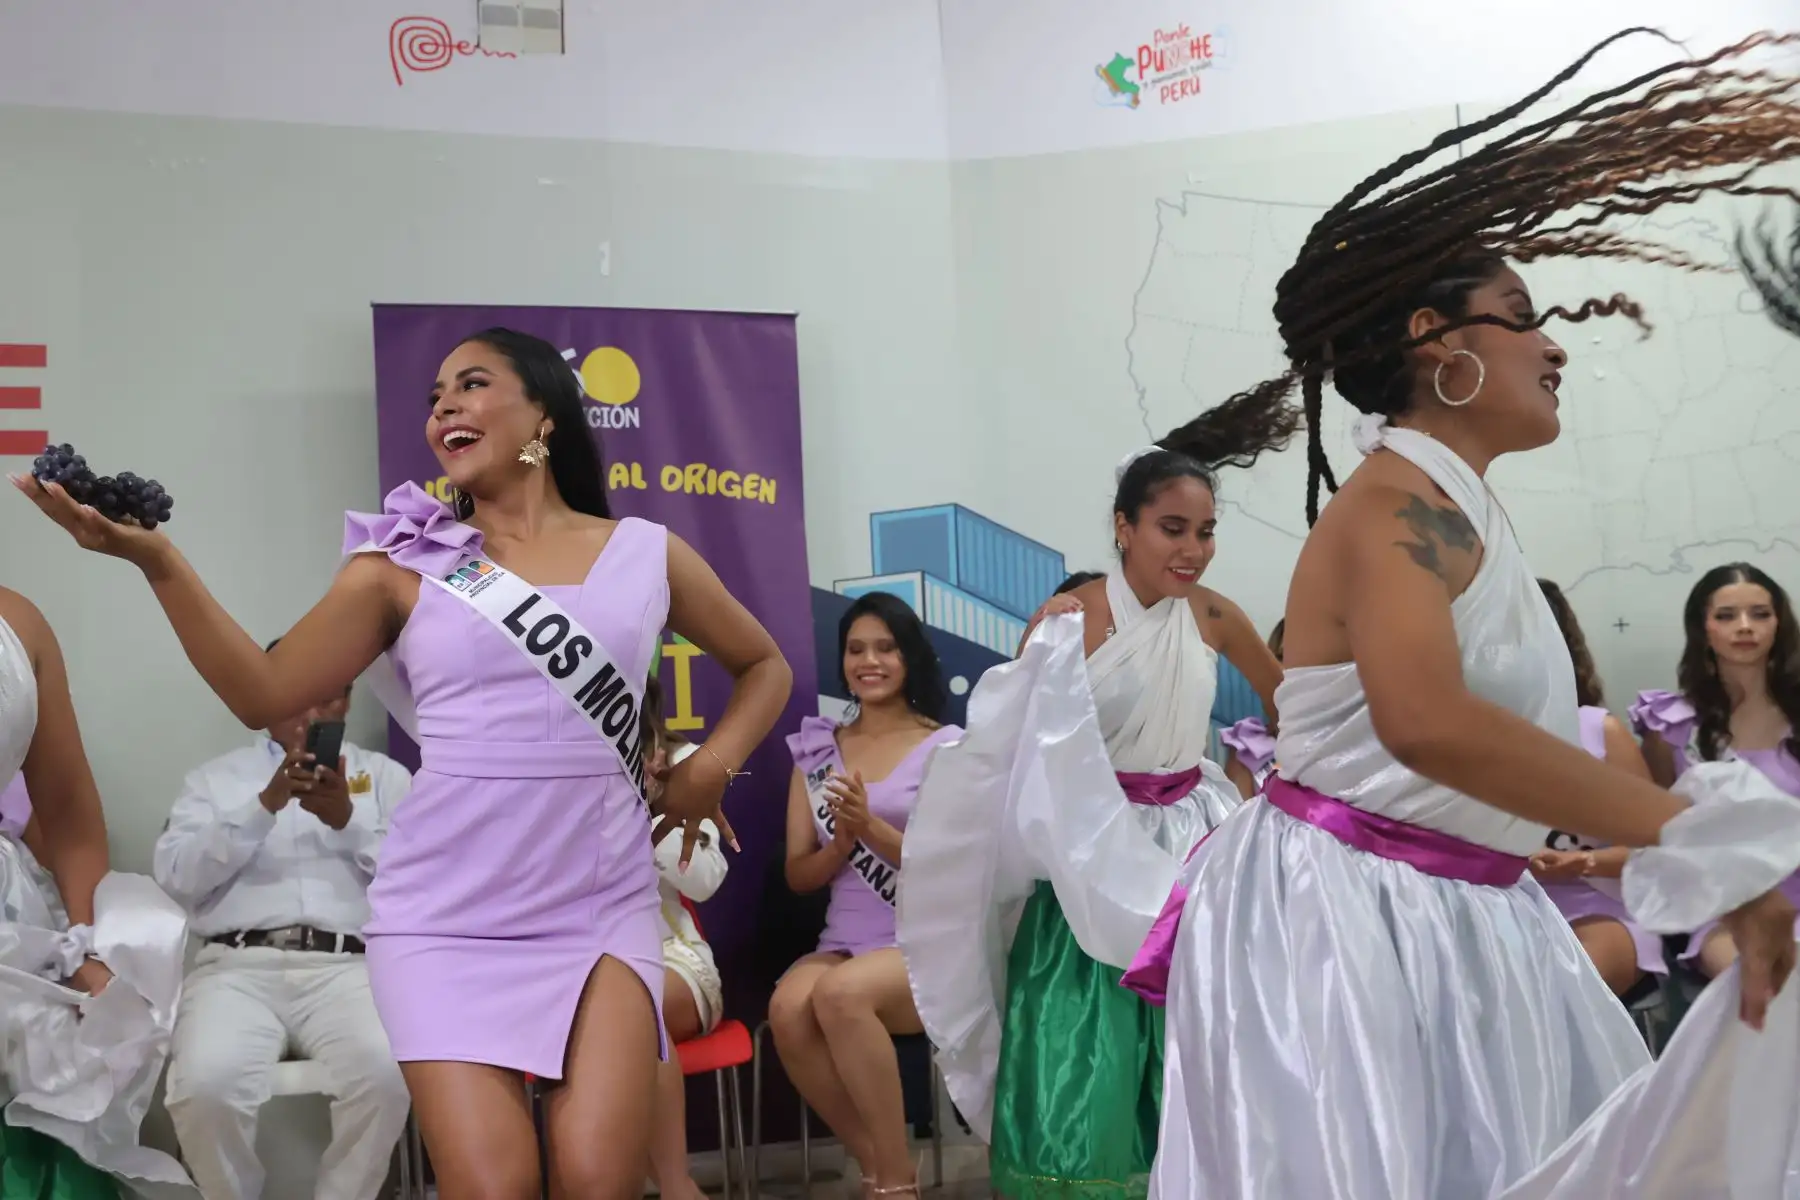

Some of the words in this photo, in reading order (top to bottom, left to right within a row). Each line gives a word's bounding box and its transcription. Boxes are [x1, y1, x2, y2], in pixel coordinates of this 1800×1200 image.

[608, 462, 648, 490] AL
[660, 463, 777, 504] ORIGEN
[502, 593, 593, 680] LOS
